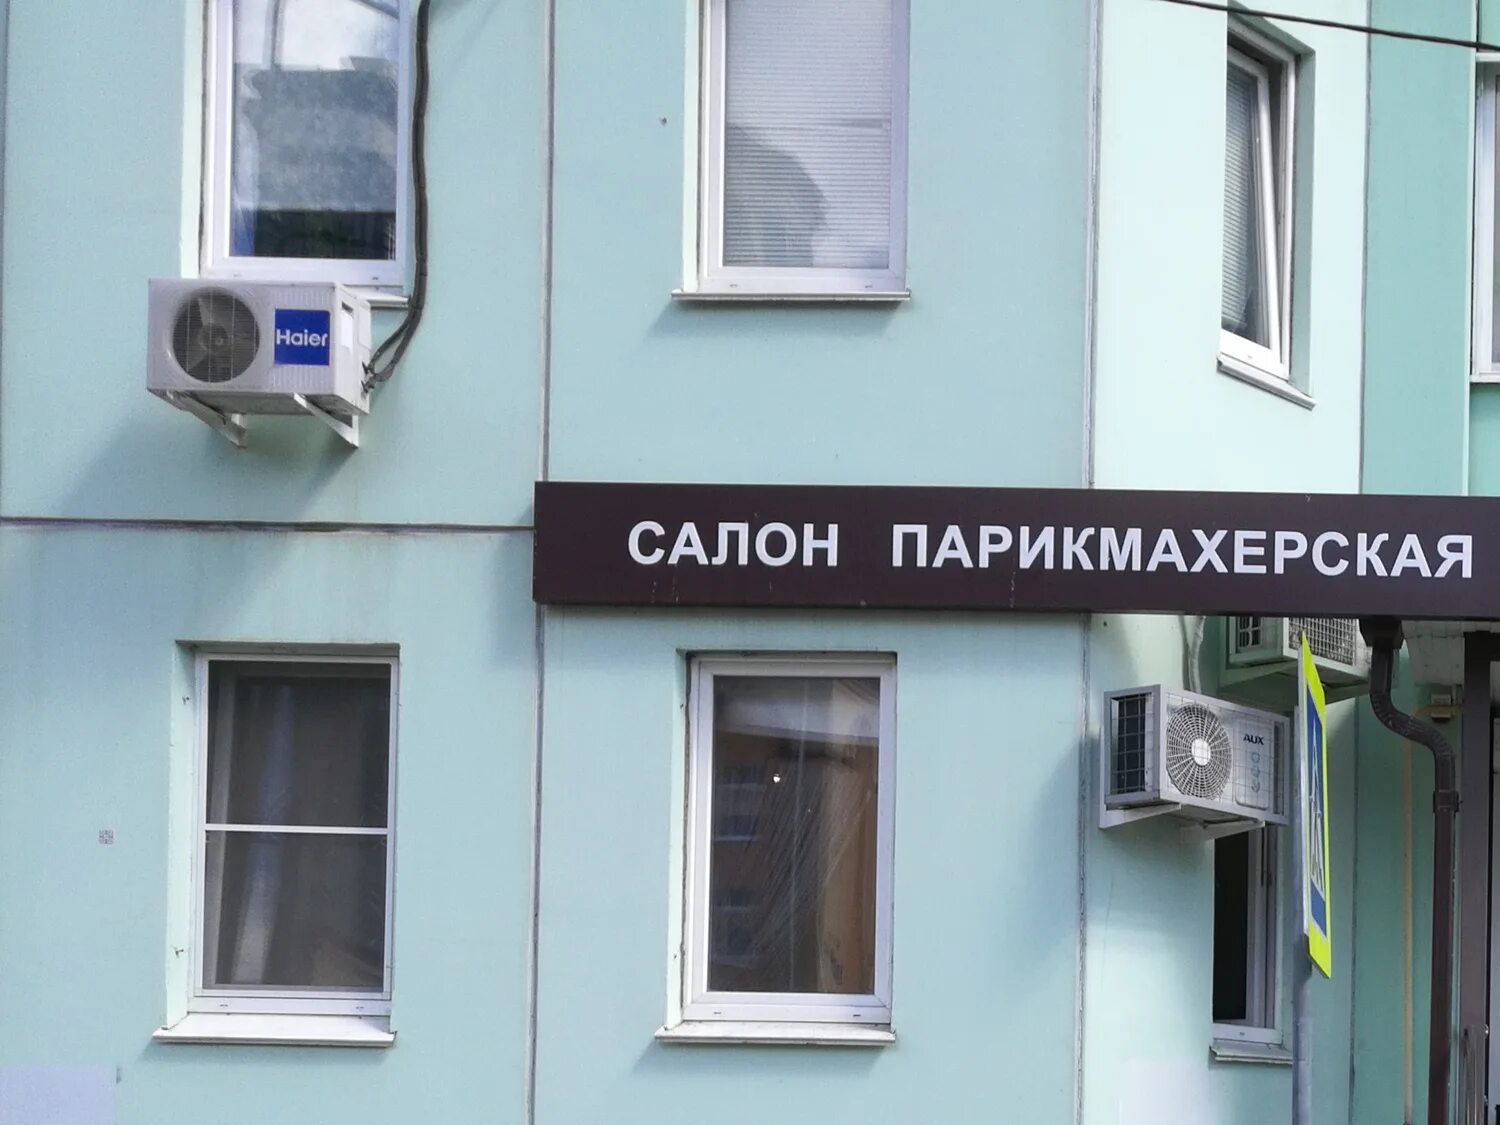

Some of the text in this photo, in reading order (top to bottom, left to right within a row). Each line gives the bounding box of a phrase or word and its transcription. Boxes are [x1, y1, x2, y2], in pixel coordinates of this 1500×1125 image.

[276, 328, 328, 347] Haier
[627, 519, 1473, 579] САЛОН ПАРИКМАХЕРСКАЯ
[1243, 734, 1264, 745] AUX
